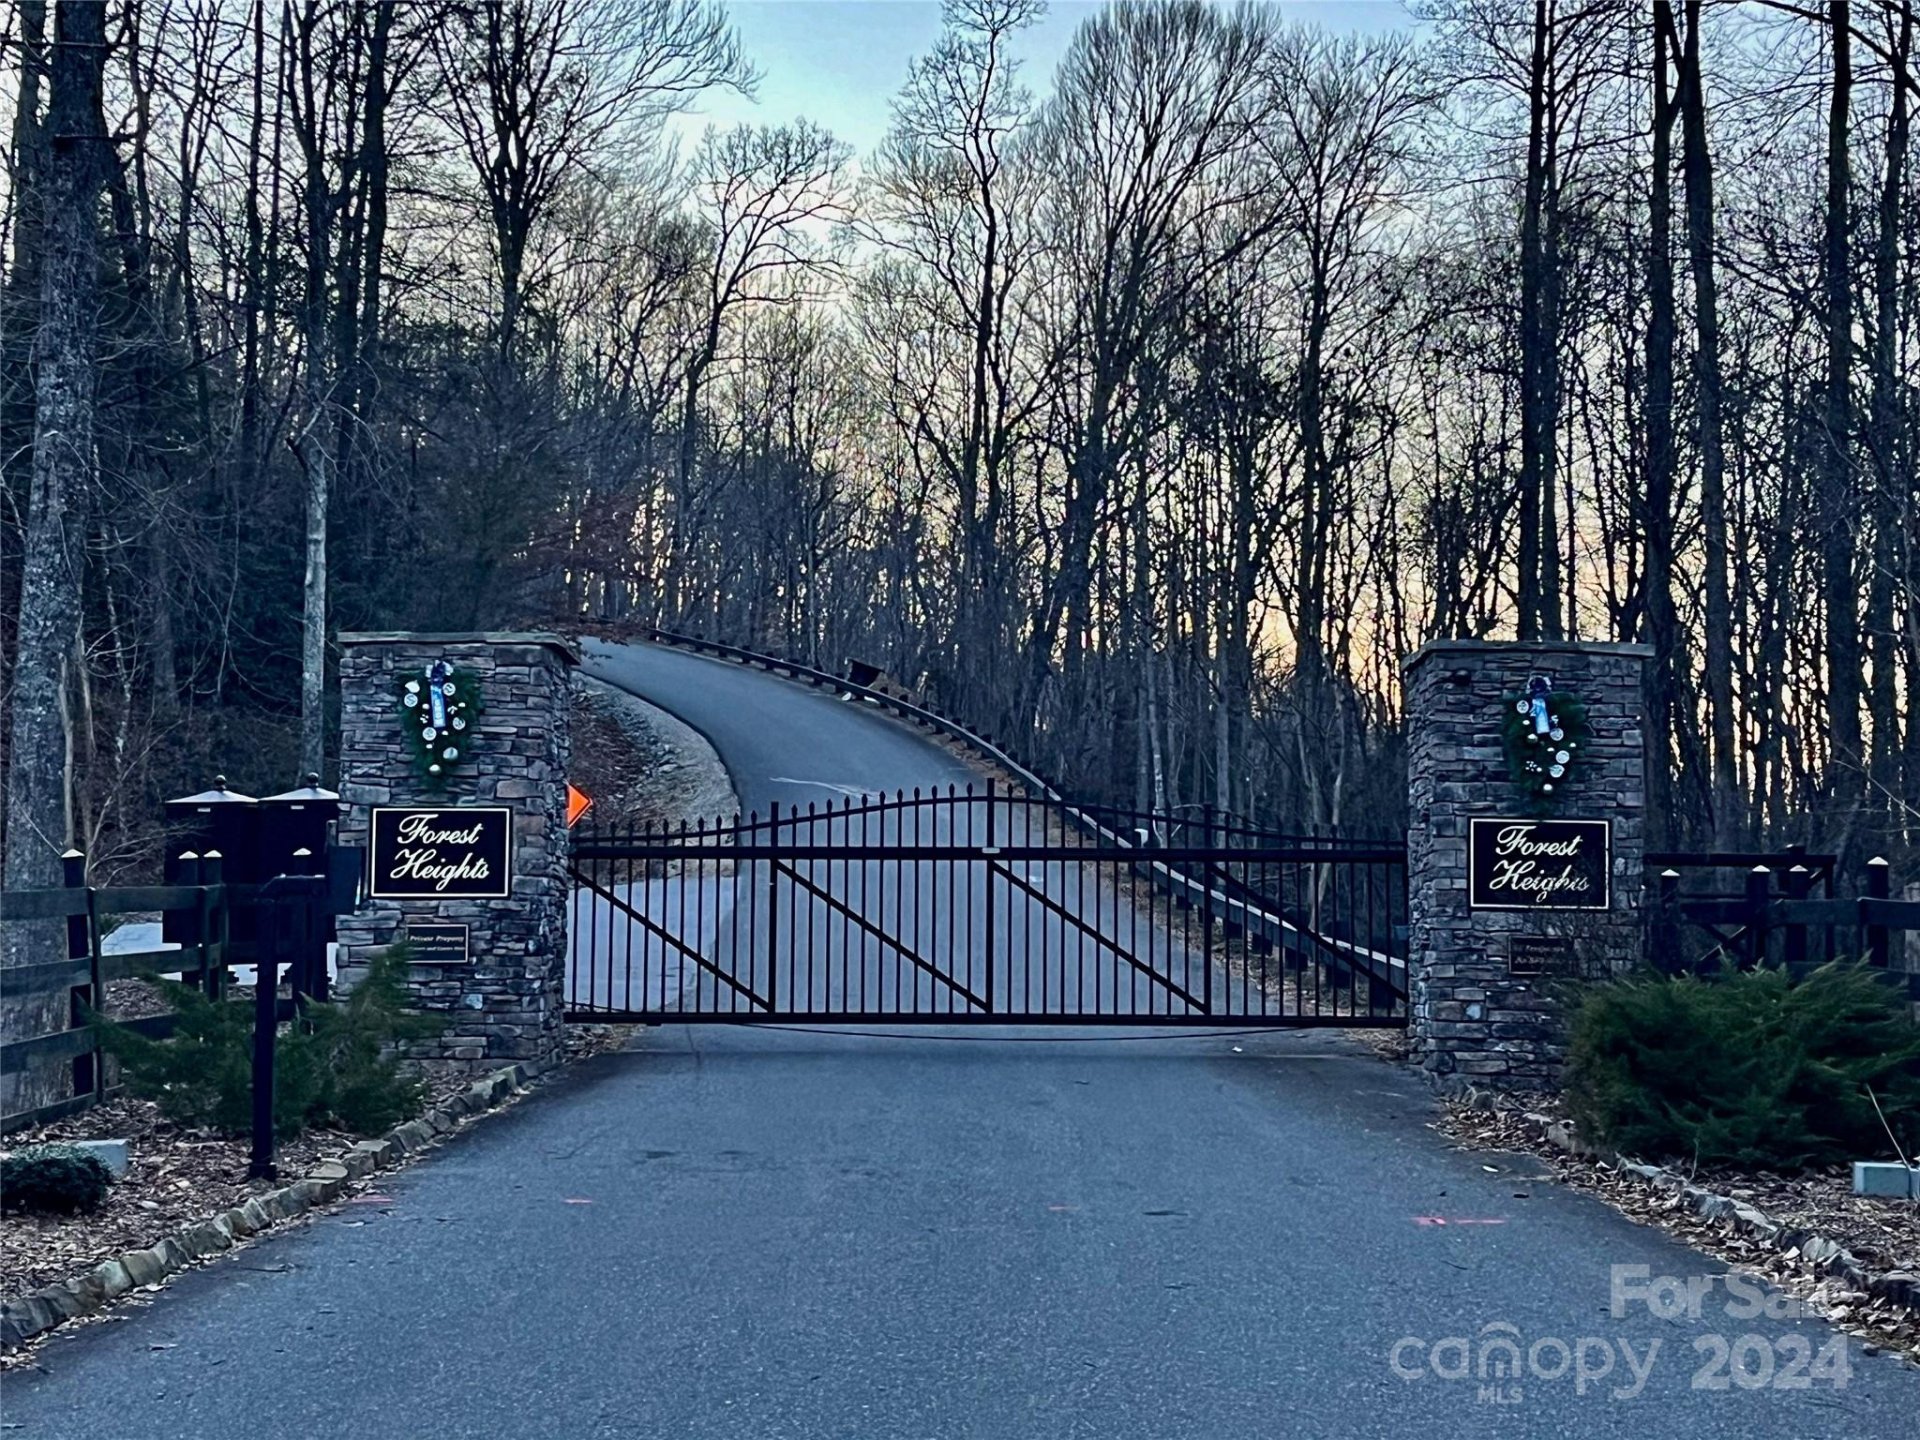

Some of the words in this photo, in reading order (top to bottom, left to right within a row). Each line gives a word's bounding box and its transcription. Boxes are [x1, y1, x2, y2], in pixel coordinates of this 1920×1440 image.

[397, 814, 484, 844] Forest
[1495, 825, 1583, 856] Forest
[390, 848, 490, 891] Heights
